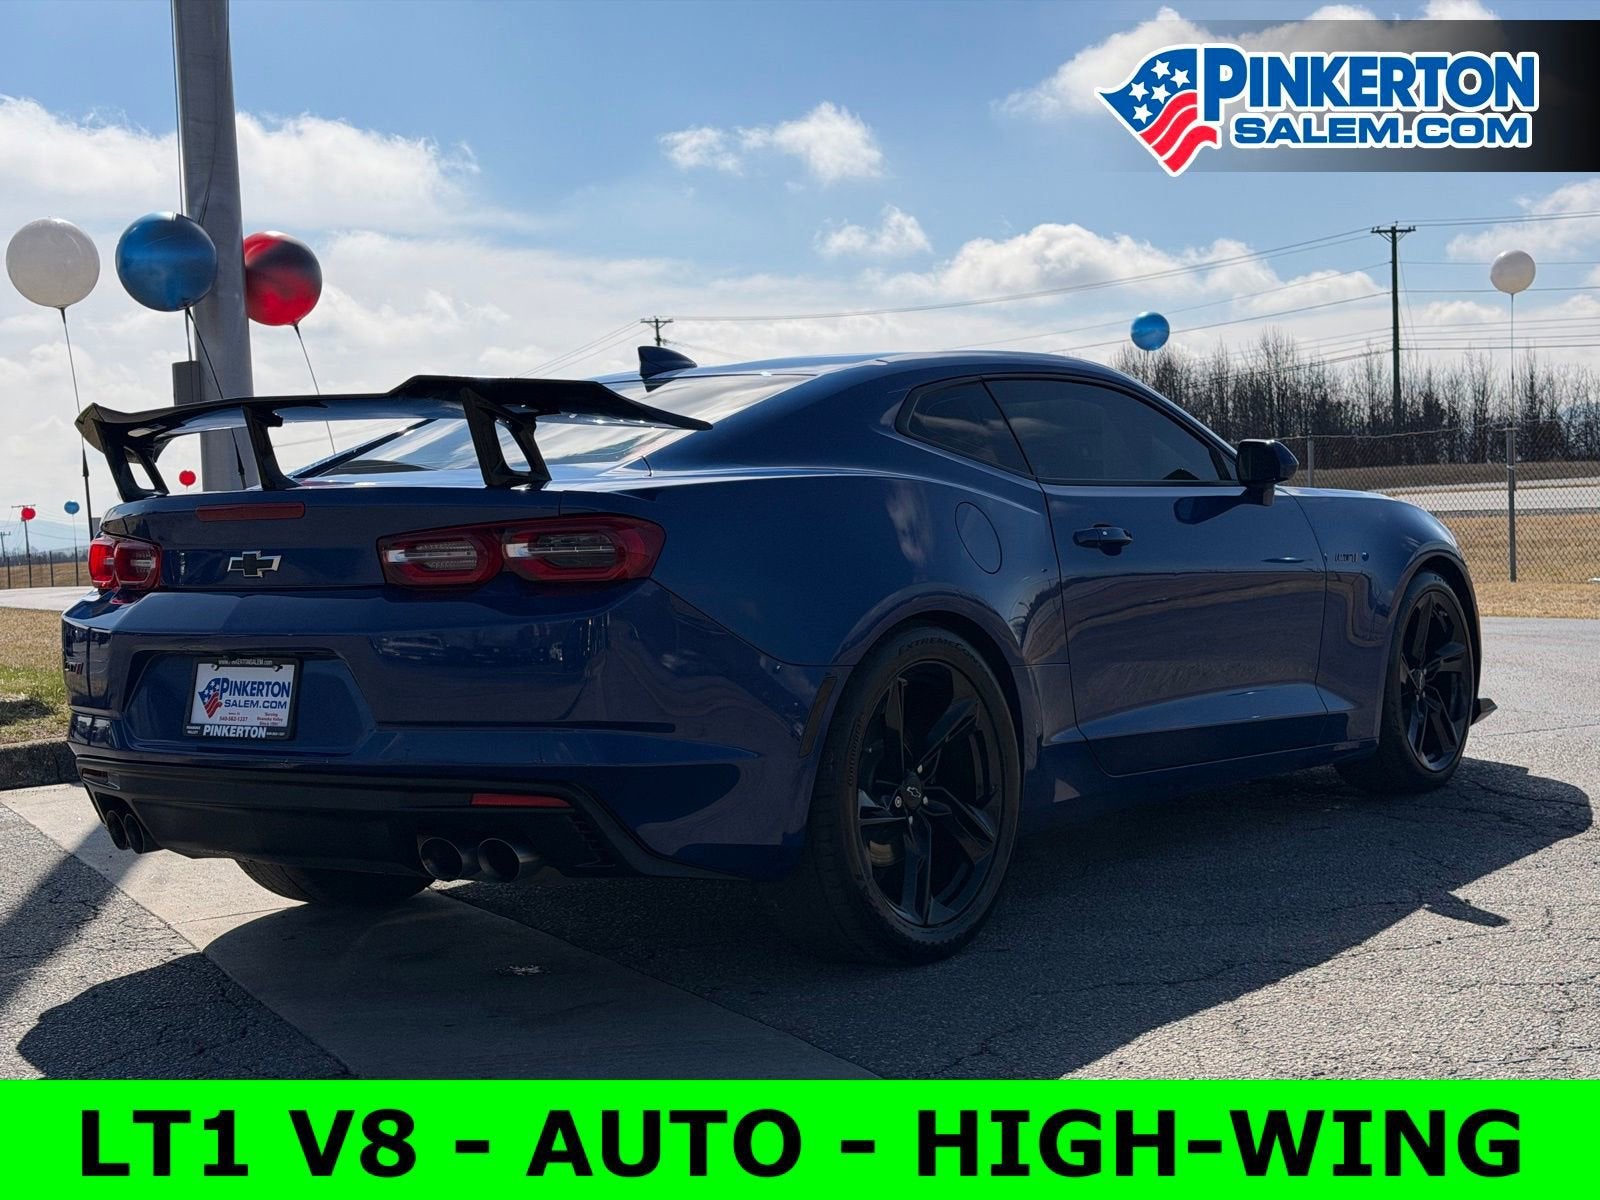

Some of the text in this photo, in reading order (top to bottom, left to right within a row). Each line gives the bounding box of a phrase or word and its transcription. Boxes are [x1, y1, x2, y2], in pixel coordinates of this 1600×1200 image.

[220, 677, 291, 701] PINKERTON
[224, 699, 287, 710] SALEM.COM
[202, 724, 268, 739] PINKERTON
